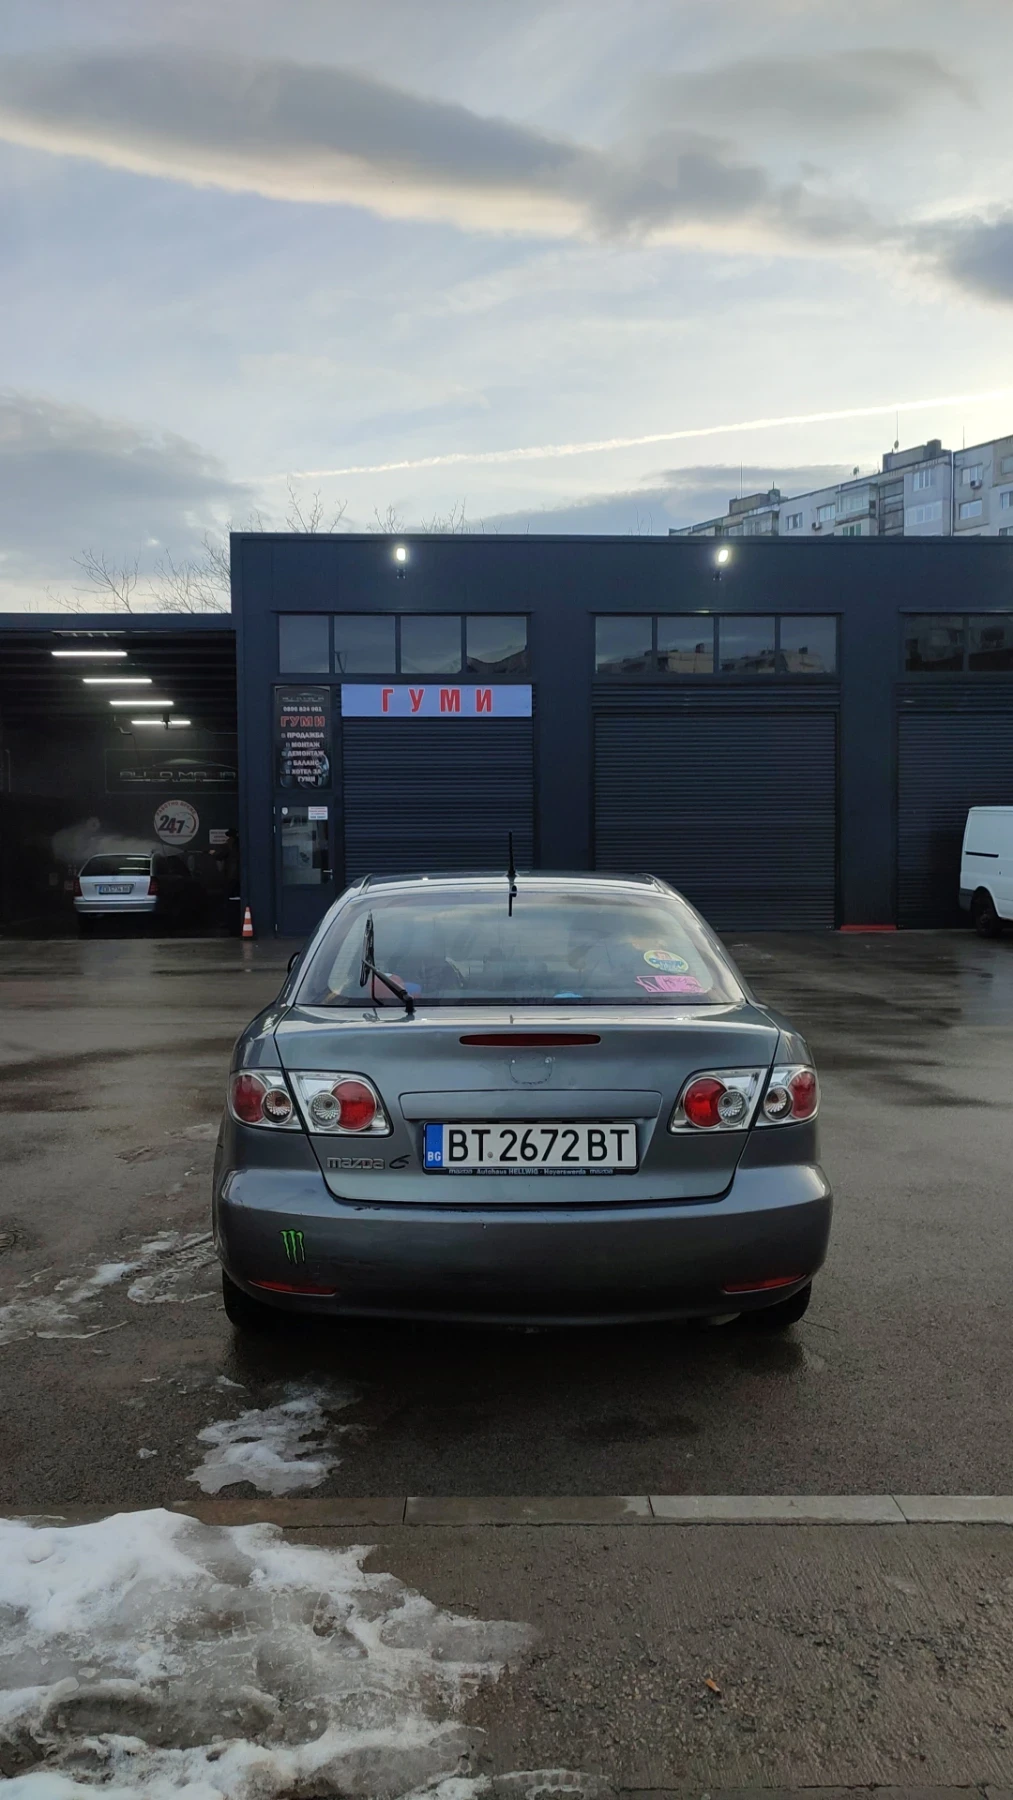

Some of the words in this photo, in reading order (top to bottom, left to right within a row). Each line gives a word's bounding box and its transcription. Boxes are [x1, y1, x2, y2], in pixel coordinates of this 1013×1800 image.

[381, 688, 493, 713] ГУМИ
[280, 715, 326, 728] ГУМИ
[499, 1129, 580, 1162] 2672
[327, 1157, 385, 1169] mazda
[389, 1155, 411, 1169] 6
[427, 1151, 442, 1161] BG
[544, 1168, 586, 1176] Hoyerswerda
